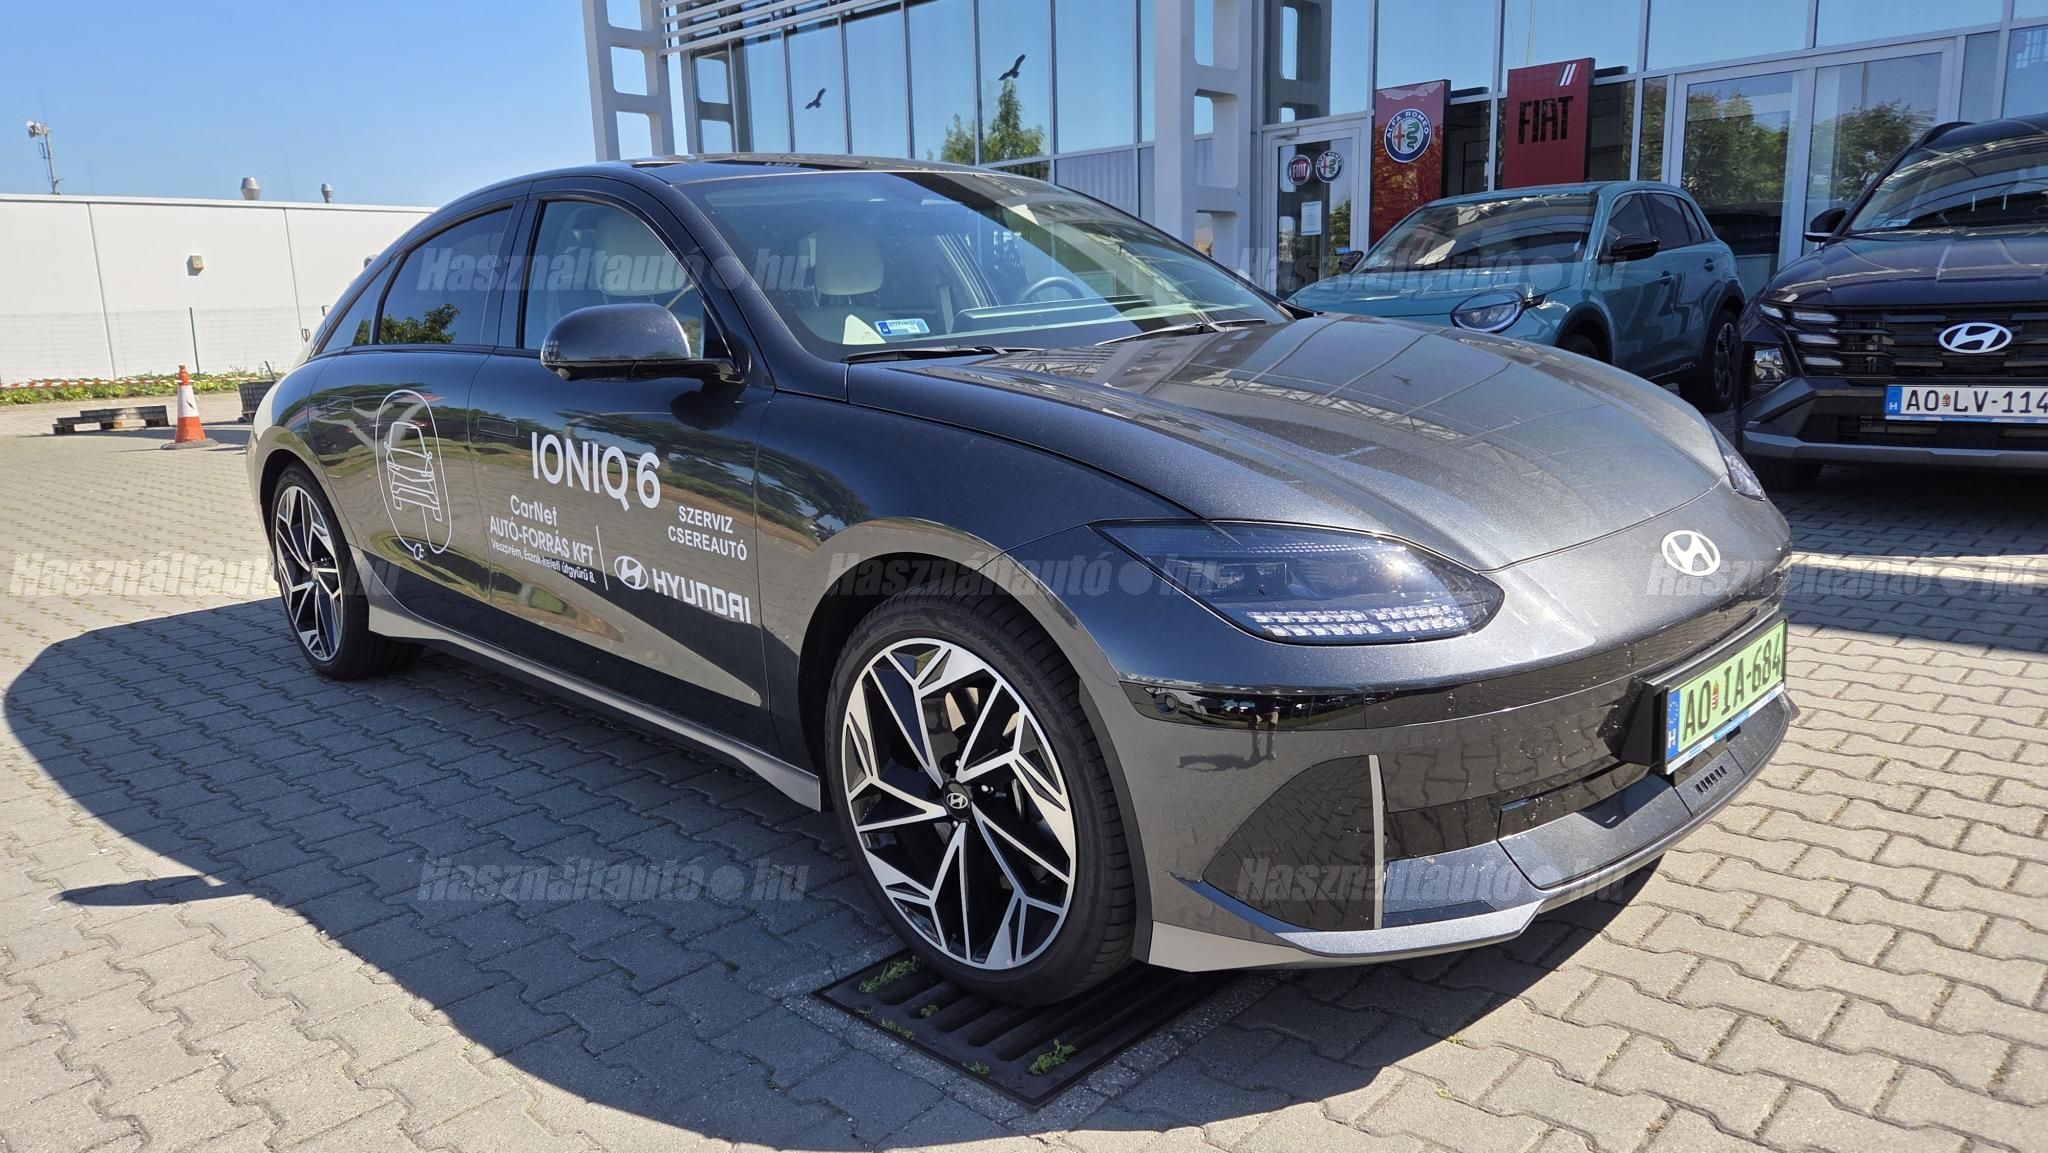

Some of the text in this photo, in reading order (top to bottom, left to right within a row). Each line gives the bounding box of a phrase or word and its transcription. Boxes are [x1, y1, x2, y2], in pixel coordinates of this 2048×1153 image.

[1386, 111, 1430, 138] ALFA ROMEO
[1517, 96, 1574, 145] FIAT
[1292, 163, 1307, 178] FIAT
[531, 431, 661, 511] IONIQ 6
[510, 494, 558, 527] CarNet
[678, 505, 734, 534] SZERVIZ
[489, 515, 594, 566] AUTÓ-FORRÁS KFT
[667, 525, 747, 561] CSEREAUTÓ
[651, 568, 752, 625] HYUNDAI
